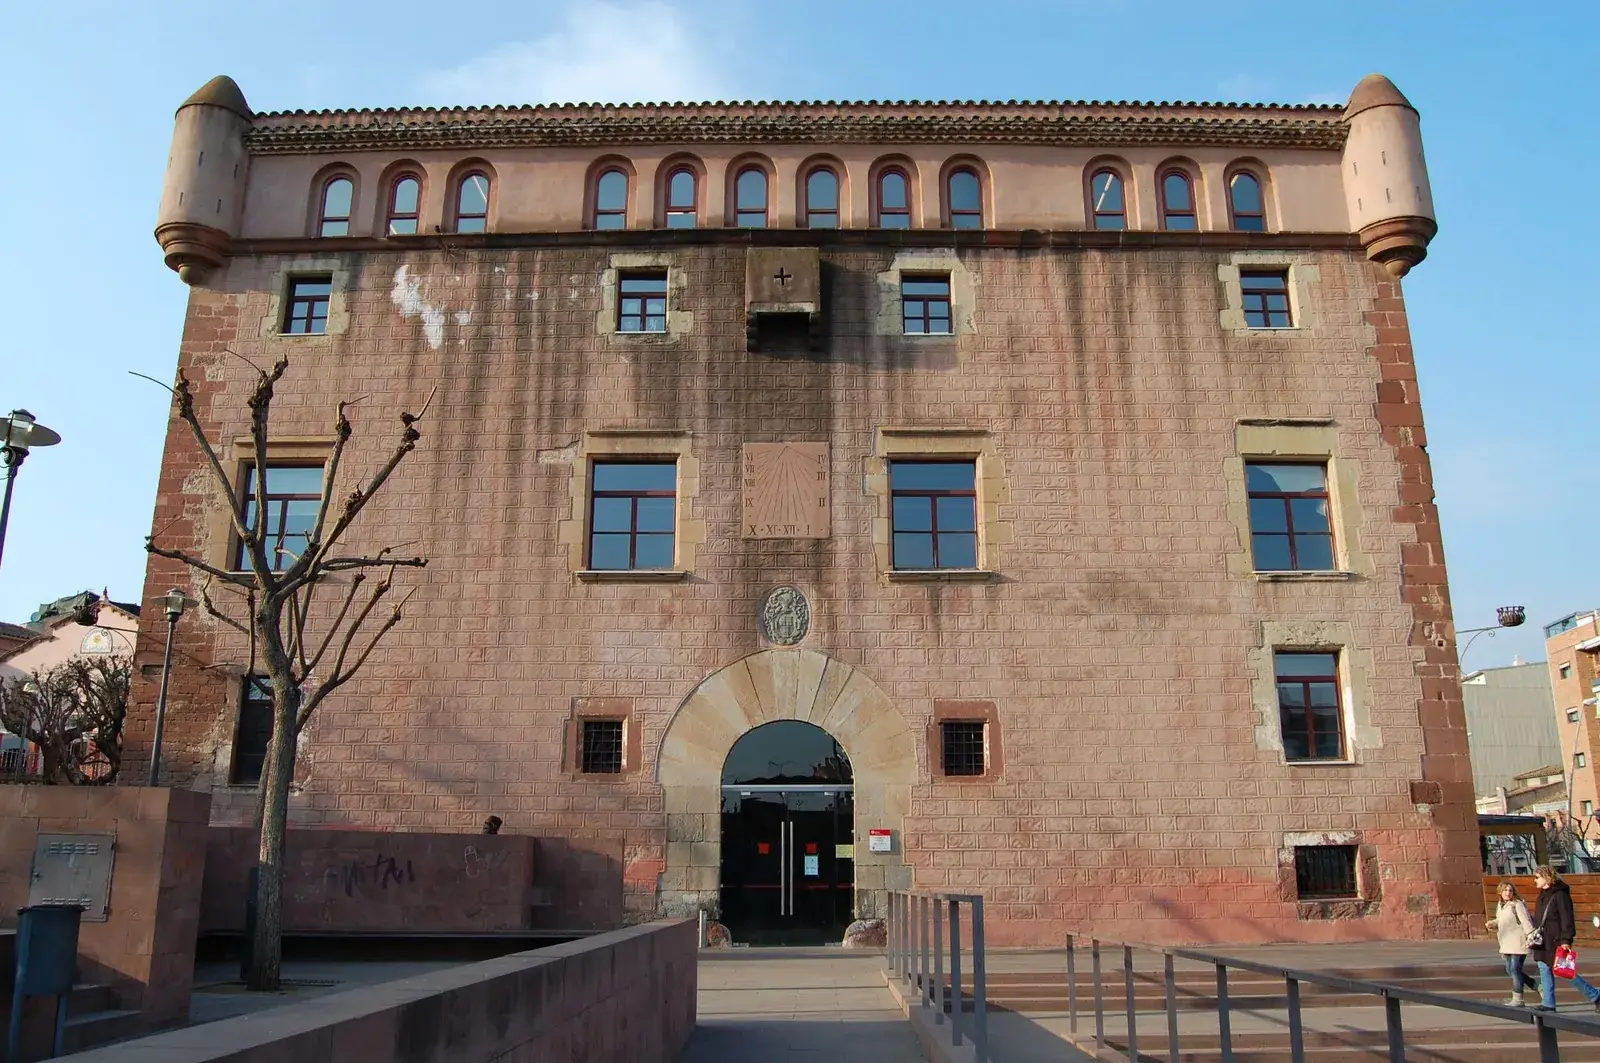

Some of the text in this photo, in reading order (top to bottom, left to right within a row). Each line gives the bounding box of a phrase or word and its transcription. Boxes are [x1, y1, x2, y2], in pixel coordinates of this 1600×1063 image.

[817, 471, 826, 480] III
[745, 498, 754, 507] IX
[819, 498, 826, 507] II
[748, 525, 757, 536] X
[783, 525, 796, 536] XII
